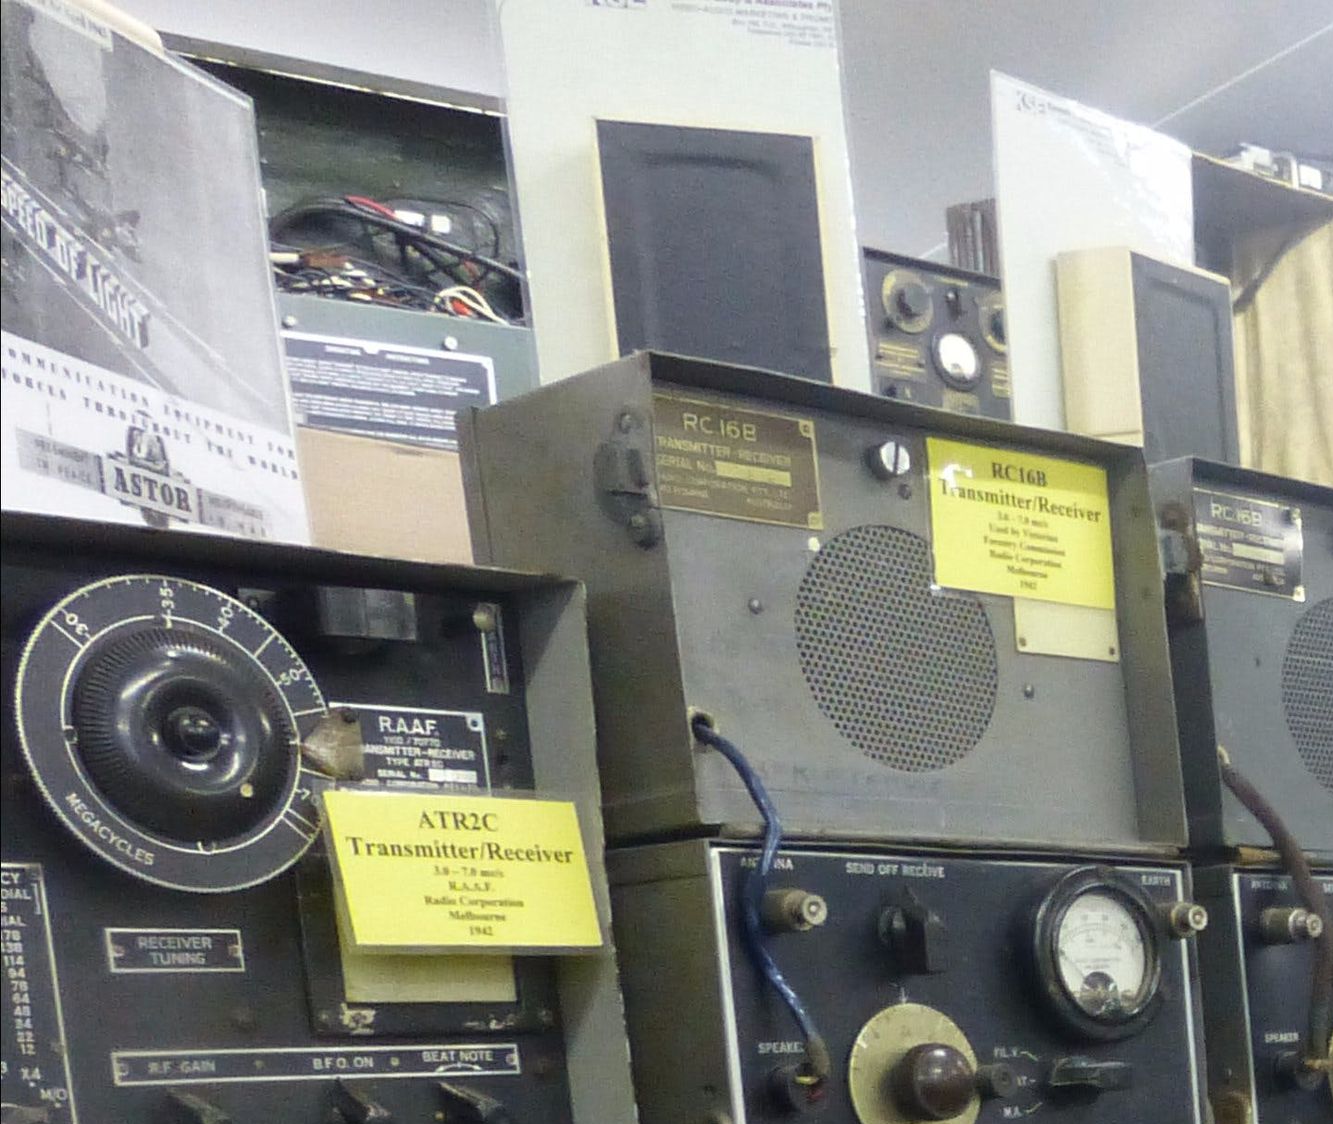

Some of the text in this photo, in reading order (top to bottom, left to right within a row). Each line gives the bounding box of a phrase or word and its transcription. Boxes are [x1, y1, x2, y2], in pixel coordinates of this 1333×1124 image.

[992, 462, 1047, 487] RC16B
[114, 467, 192, 513] ASTOR
[65, 792, 154, 866] MEGACYCLES
[418, 811, 500, 832] ATR2C
[346, 836, 573, 864] Transmitter/Receiver
[846, 862, 945, 878] SEND OFF RECEIVE
[138, 936, 213, 950] RECEIVER
[151, 953, 206, 965] TUNING
[758, 1041, 805, 1054] SPEAKE
[353, 1056, 374, 1068] ON
[422, 1051, 494, 1063] BEAT NOTE
[180, 1060, 216, 1072] GAIN
